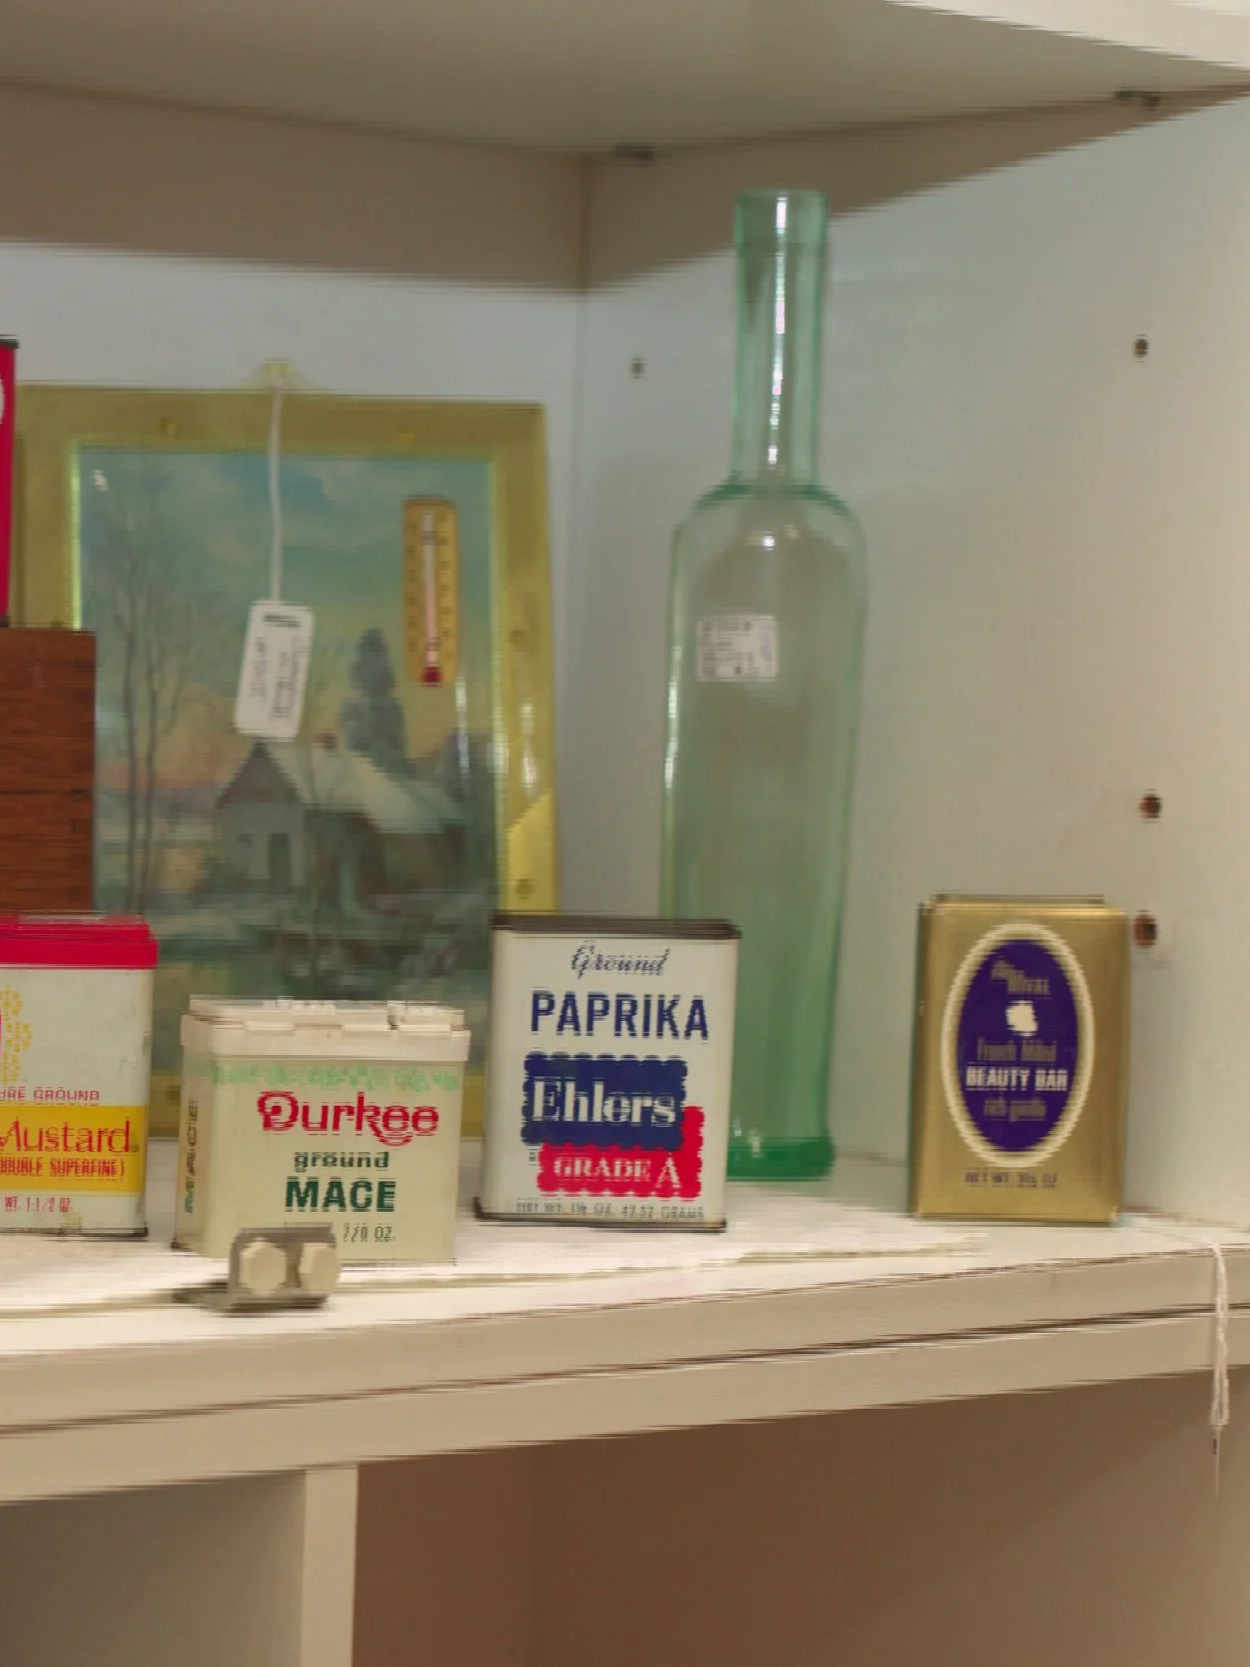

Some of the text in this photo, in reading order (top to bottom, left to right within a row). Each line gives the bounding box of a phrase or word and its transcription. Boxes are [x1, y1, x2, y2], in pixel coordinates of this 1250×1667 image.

[571, 941, 670, 979] Ground
[531, 989, 709, 1041] PAPRIKA
[966, 1065, 1068, 1091] BEAUTY BAR
[33, 1088, 100, 1104] GROUND
[533, 1076, 677, 1126] Ehlers
[257, 1091, 440, 1147] Durkee
[50, 1157, 125, 1179] SUPERFINE)
[294, 1151, 390, 1172] ground
[554, 1157, 651, 1180] GRADE
[655, 1153, 681, 1188] A
[285, 1177, 397, 1212] MACE
